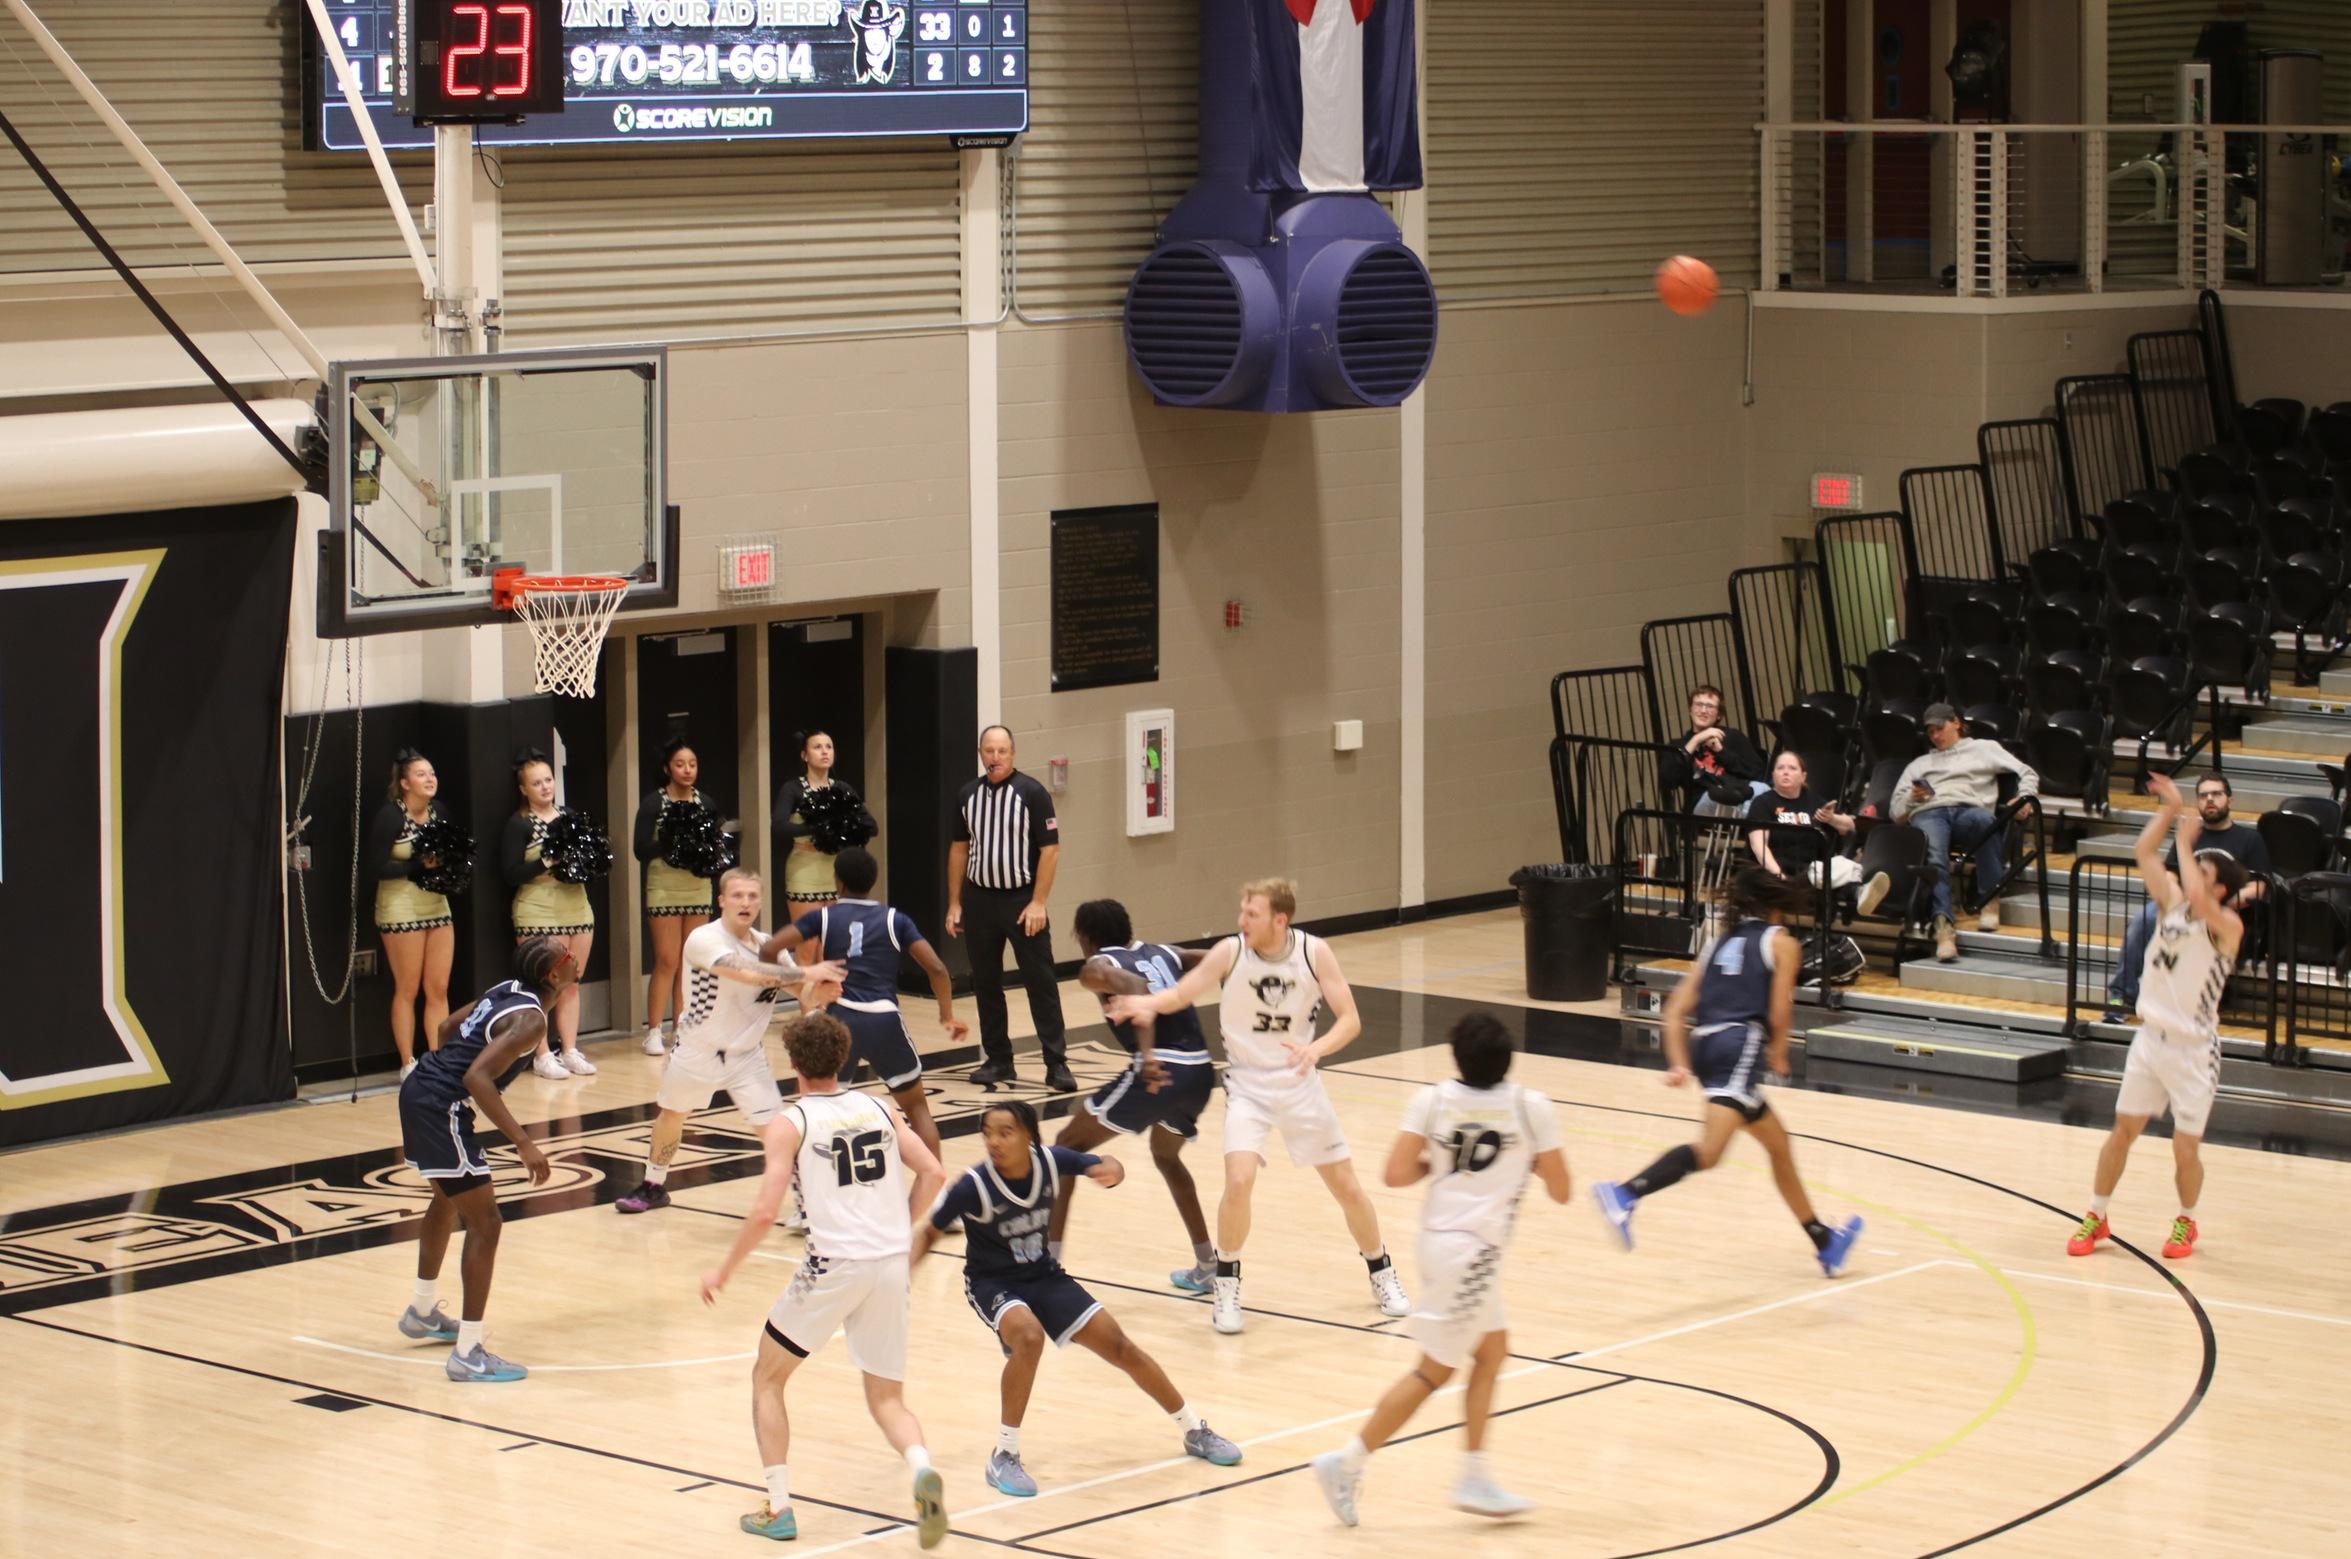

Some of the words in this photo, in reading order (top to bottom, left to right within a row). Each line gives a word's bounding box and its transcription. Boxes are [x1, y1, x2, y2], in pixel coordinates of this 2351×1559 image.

[562, 0, 626, 26] ANT
[633, 0, 711, 26] YOUR
[713, 0, 755, 26] AD
[756, 0, 842, 26] HERE?
[919, 12, 951, 41] 33
[968, 14, 981, 38] 0
[1002, 14, 1016, 38] 1
[341, 16, 359, 47] 4
[447, 6, 531, 96] 23
[570, 43, 815, 85] 970-521-6614
[927, 52, 944, 81] 2
[967, 54, 982, 78] 8
[1002, 54, 1016, 77] 2
[636, 106, 773, 130] SCOREVISION
[737, 551, 770, 586] EXIT
[847, 920, 864, 958] 1
[1711, 936, 1747, 976] 4
[831, 1129, 886, 1187] 15
